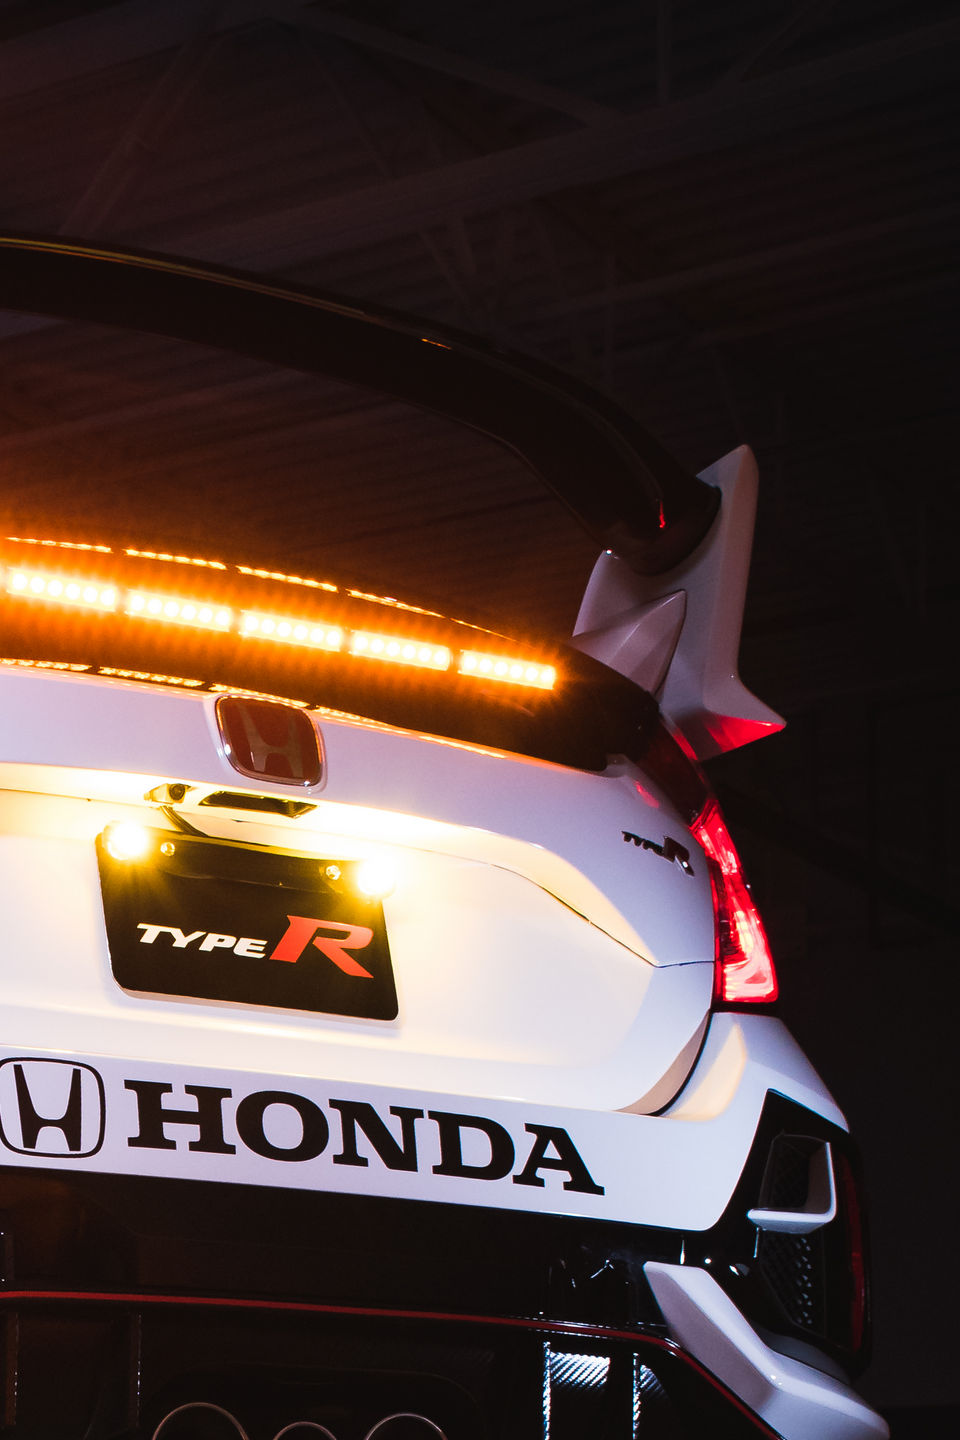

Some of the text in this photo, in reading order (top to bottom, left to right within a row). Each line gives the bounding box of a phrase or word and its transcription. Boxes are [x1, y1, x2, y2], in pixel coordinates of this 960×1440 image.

[621, 830, 695, 877] TYPE R
[137, 915, 374, 979] TYPE R
[124, 1079, 605, 1195] HONDA
